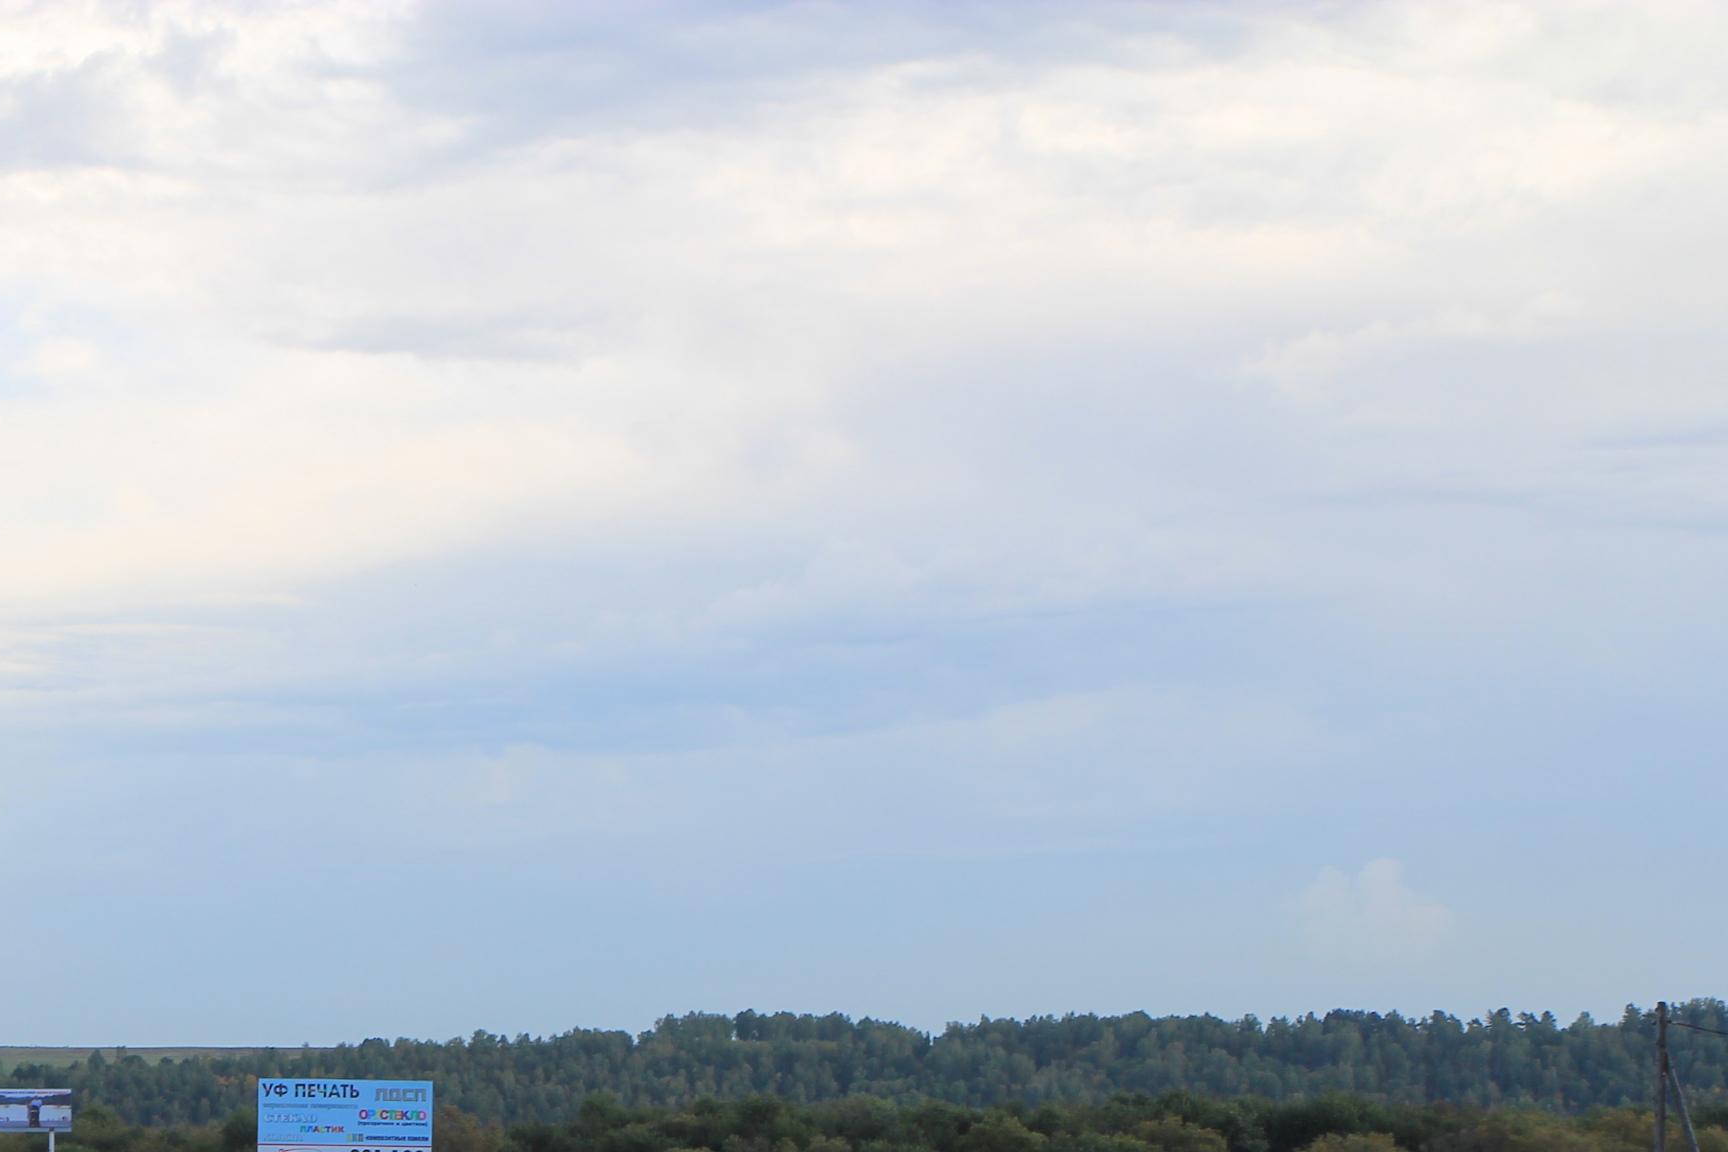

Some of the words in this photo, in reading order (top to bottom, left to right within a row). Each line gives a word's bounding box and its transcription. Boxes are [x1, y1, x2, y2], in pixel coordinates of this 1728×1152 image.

[262, 1083, 288, 1097] УФ
[294, 1083, 360, 1098] ПЕЧАТЬ
[374, 1088, 427, 1102] ЛДСП
[263, 1113, 318, 1123] СТЕКЛО
[358, 1109, 427, 1120] ОРГСТЕКЛО
